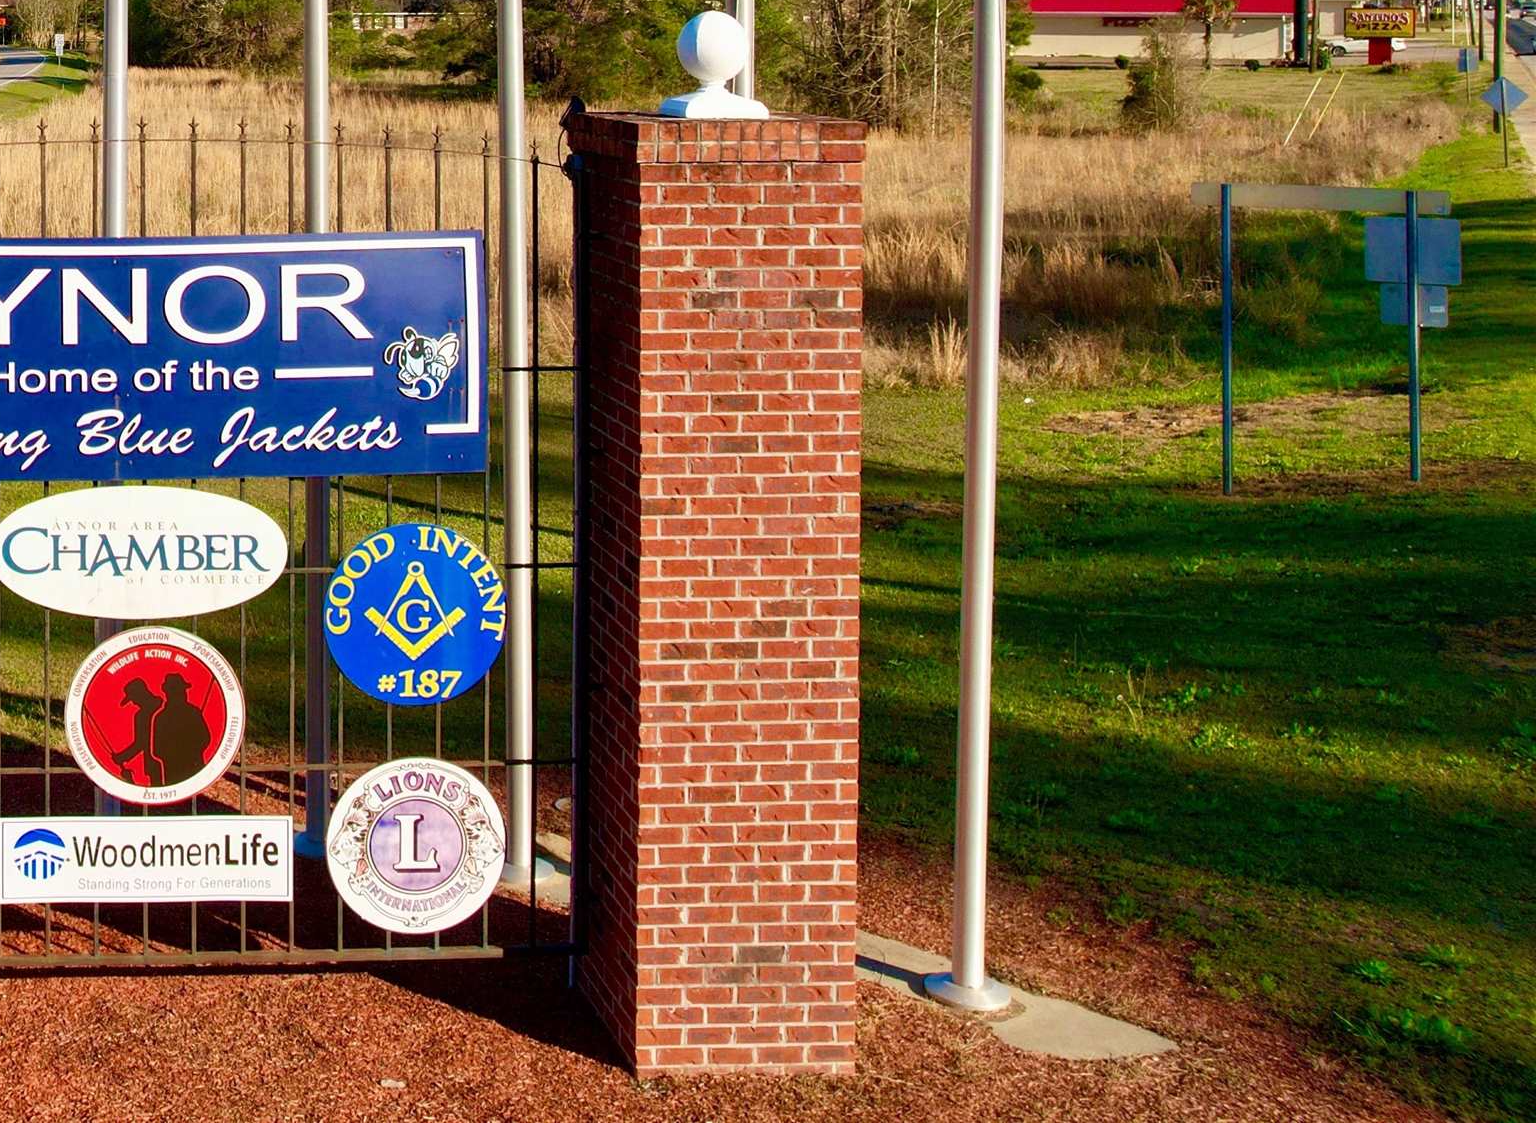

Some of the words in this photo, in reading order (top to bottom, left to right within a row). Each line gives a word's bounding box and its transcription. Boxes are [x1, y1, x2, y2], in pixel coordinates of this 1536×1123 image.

[1356, 22, 1402, 30] PIZZA
[133, 360, 184, 393] of
[190, 359, 260, 391] the
[77, 409, 195, 457] Blue
[212, 406, 402, 469] Jackets
[51, 520, 117, 531] AYNOR
[130, 521, 180, 531] AREA
[1, 526, 271, 577] CHAMBER
[126, 576, 145, 584] of
[160, 575, 266, 585] COMMERCE
[326, 532, 395, 635] GOOD
[417, 526, 506, 642] INTENT
[396, 599, 432, 633] G
[128, 632, 170, 644] EDUCATION
[107, 651, 140, 675] WILDLIFE
[144, 649, 172, 660] ACTION
[192, 642, 237, 692] SPORTSMANSHIP
[377, 668, 462, 698] #187
[70, 721, 96, 771] PRESERVATION
[220, 716, 239, 760] FELLOWSHIP
[372, 771, 461, 802] LIONS
[73, 833, 280, 868] WoodmenLife
[393, 814, 440, 873] L
[78, 877, 129, 892] Standing
[134, 878, 172, 892] Strong
[176, 877, 195, 889] For
[199, 877, 271, 889] Generations
[366, 881, 467, 912] INTERNATIONAL
